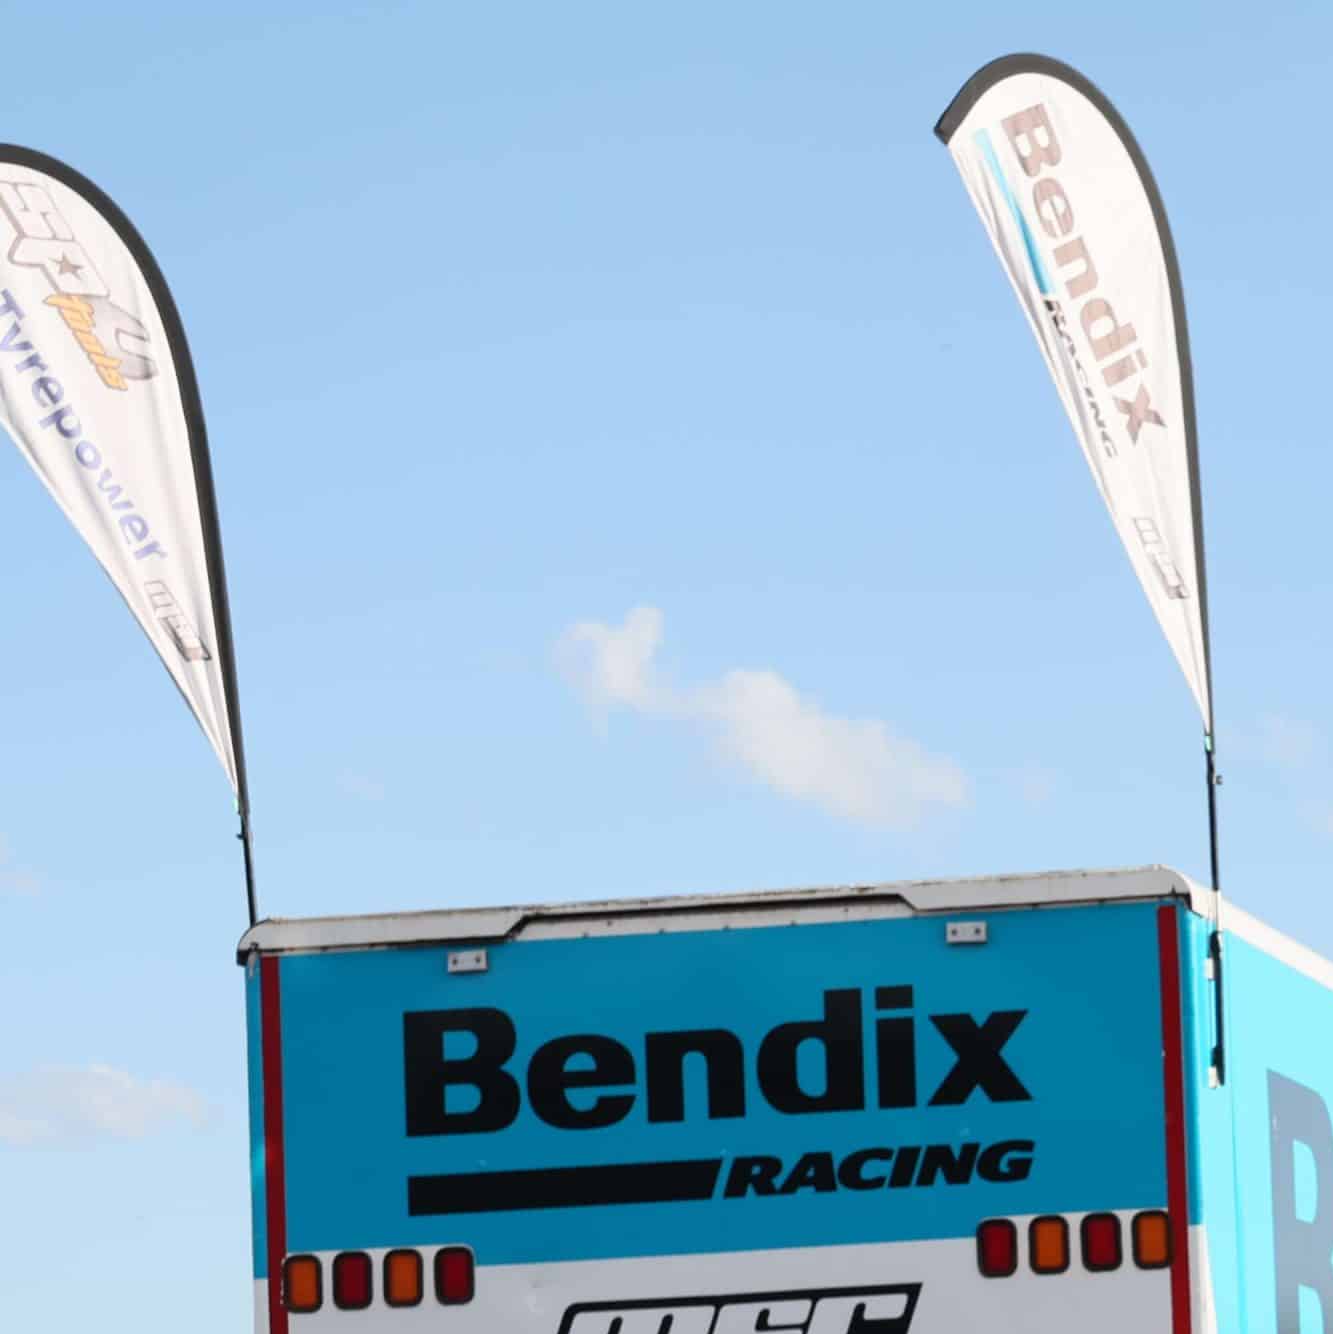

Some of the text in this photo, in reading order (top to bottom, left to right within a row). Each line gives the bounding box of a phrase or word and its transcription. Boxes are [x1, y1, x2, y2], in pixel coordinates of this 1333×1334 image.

[1001, 102, 1167, 447] Bendix
[402, 983, 1035, 1138] Bendix
[723, 1139, 1036, 1200] RACING
